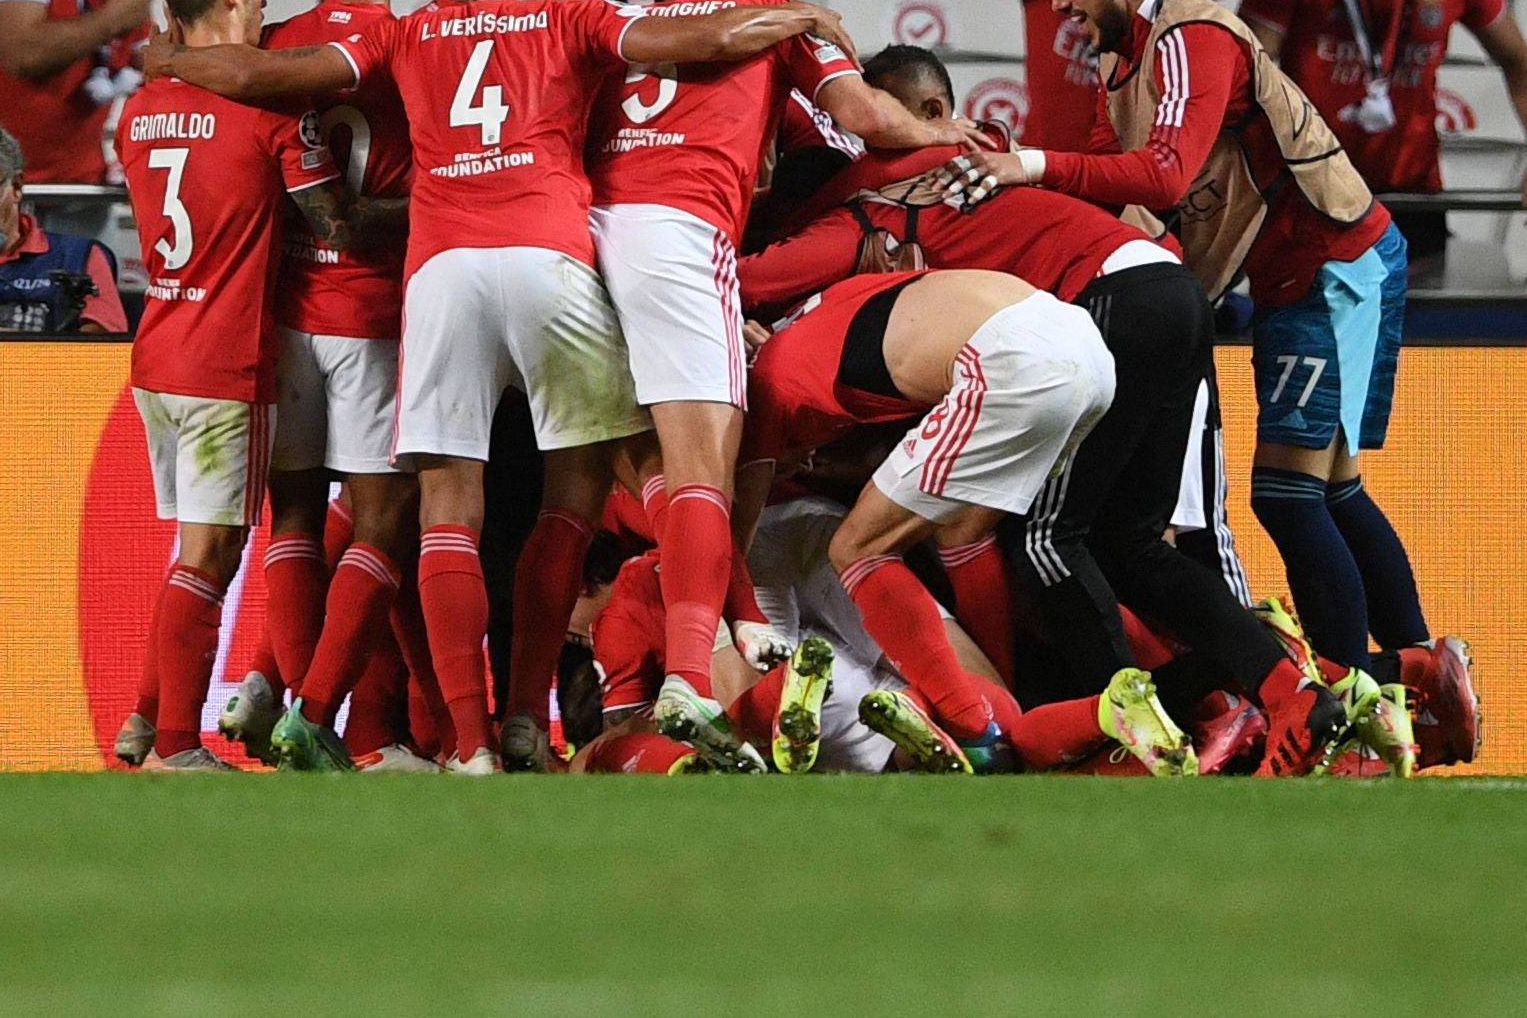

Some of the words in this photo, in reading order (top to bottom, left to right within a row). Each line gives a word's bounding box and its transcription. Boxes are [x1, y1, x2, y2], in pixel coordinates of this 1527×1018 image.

[421, 23, 436, 42] L.
[440, 10, 549, 38] VERÍSSIMO
[449, 39, 510, 146] 4
[130, 112, 216, 142] GRIMALDO
[147, 147, 194, 271] 3
[1269, 355, 1328, 408] 77
